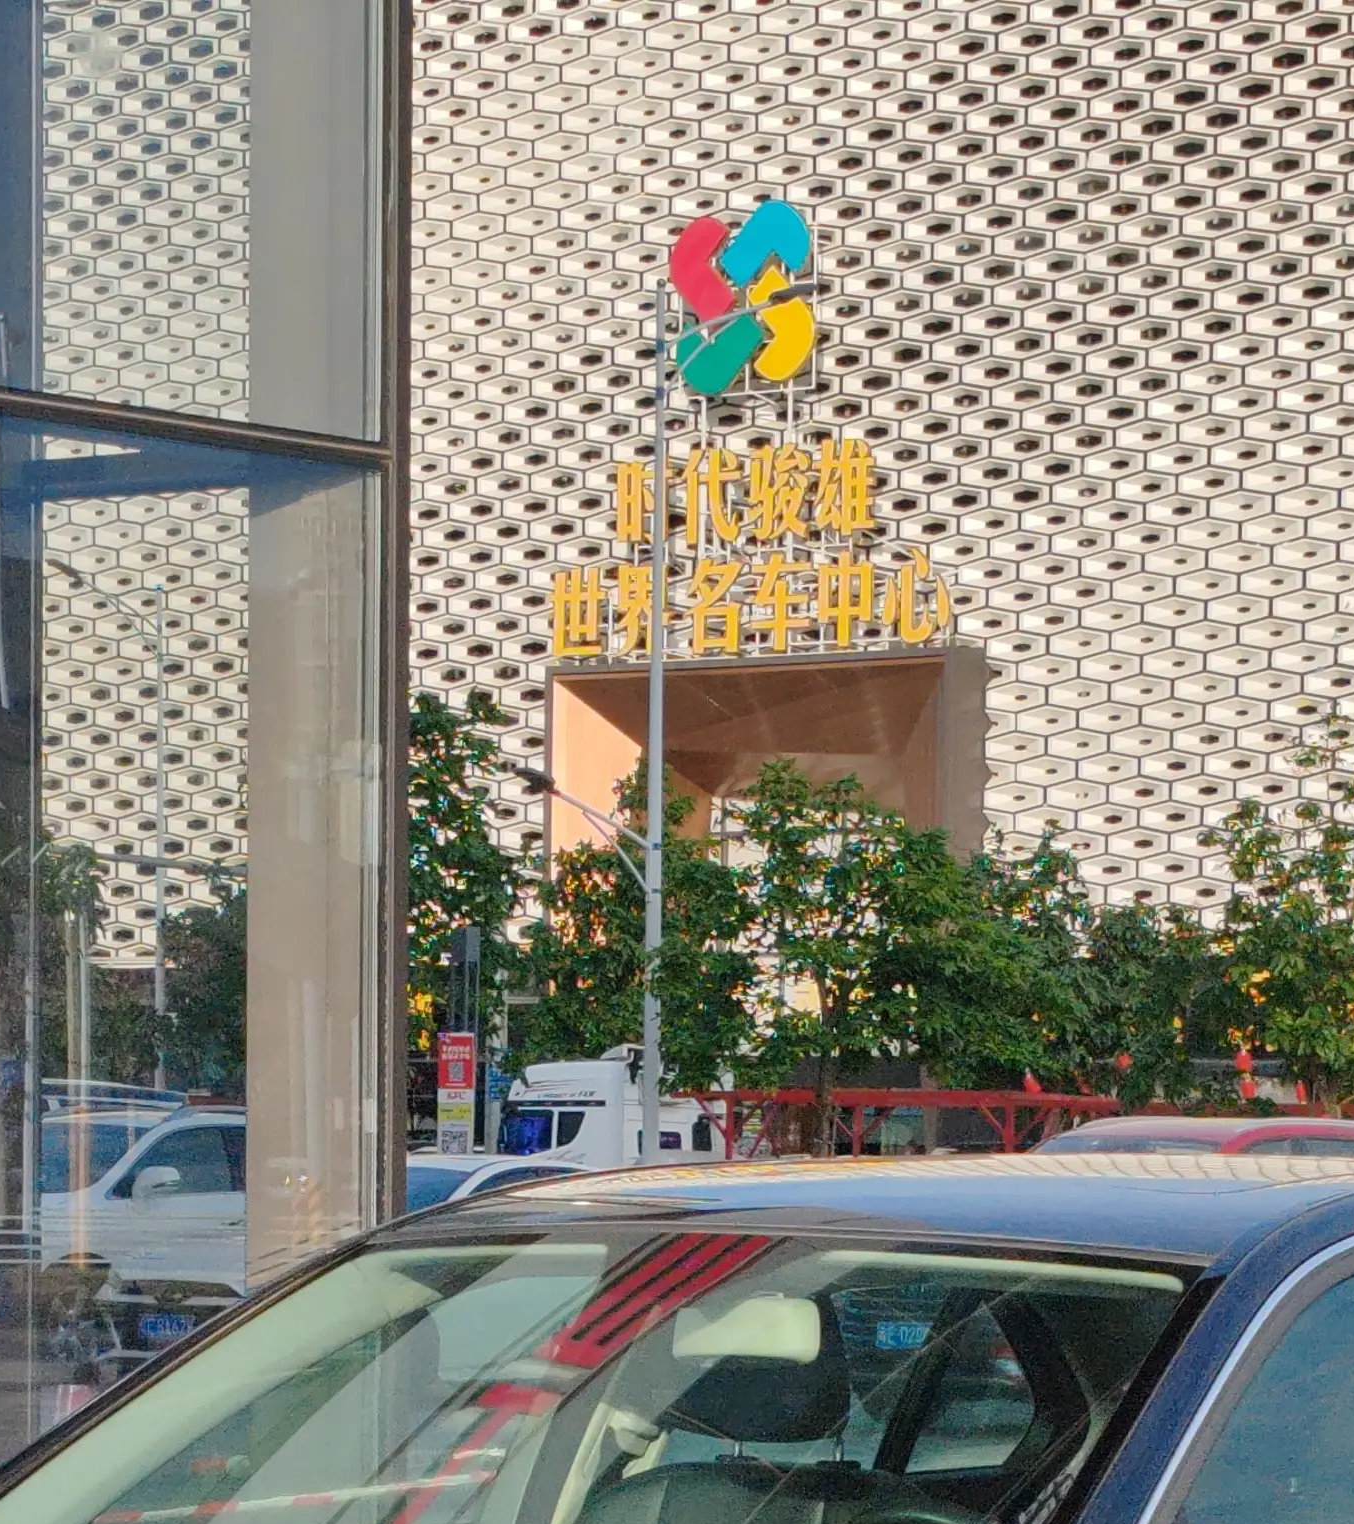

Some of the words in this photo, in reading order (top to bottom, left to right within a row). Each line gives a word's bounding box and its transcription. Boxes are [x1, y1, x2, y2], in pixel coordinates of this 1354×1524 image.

[615, 437, 876, 545] 时代骏雄
[549, 546, 951, 658] 世界名车中心
